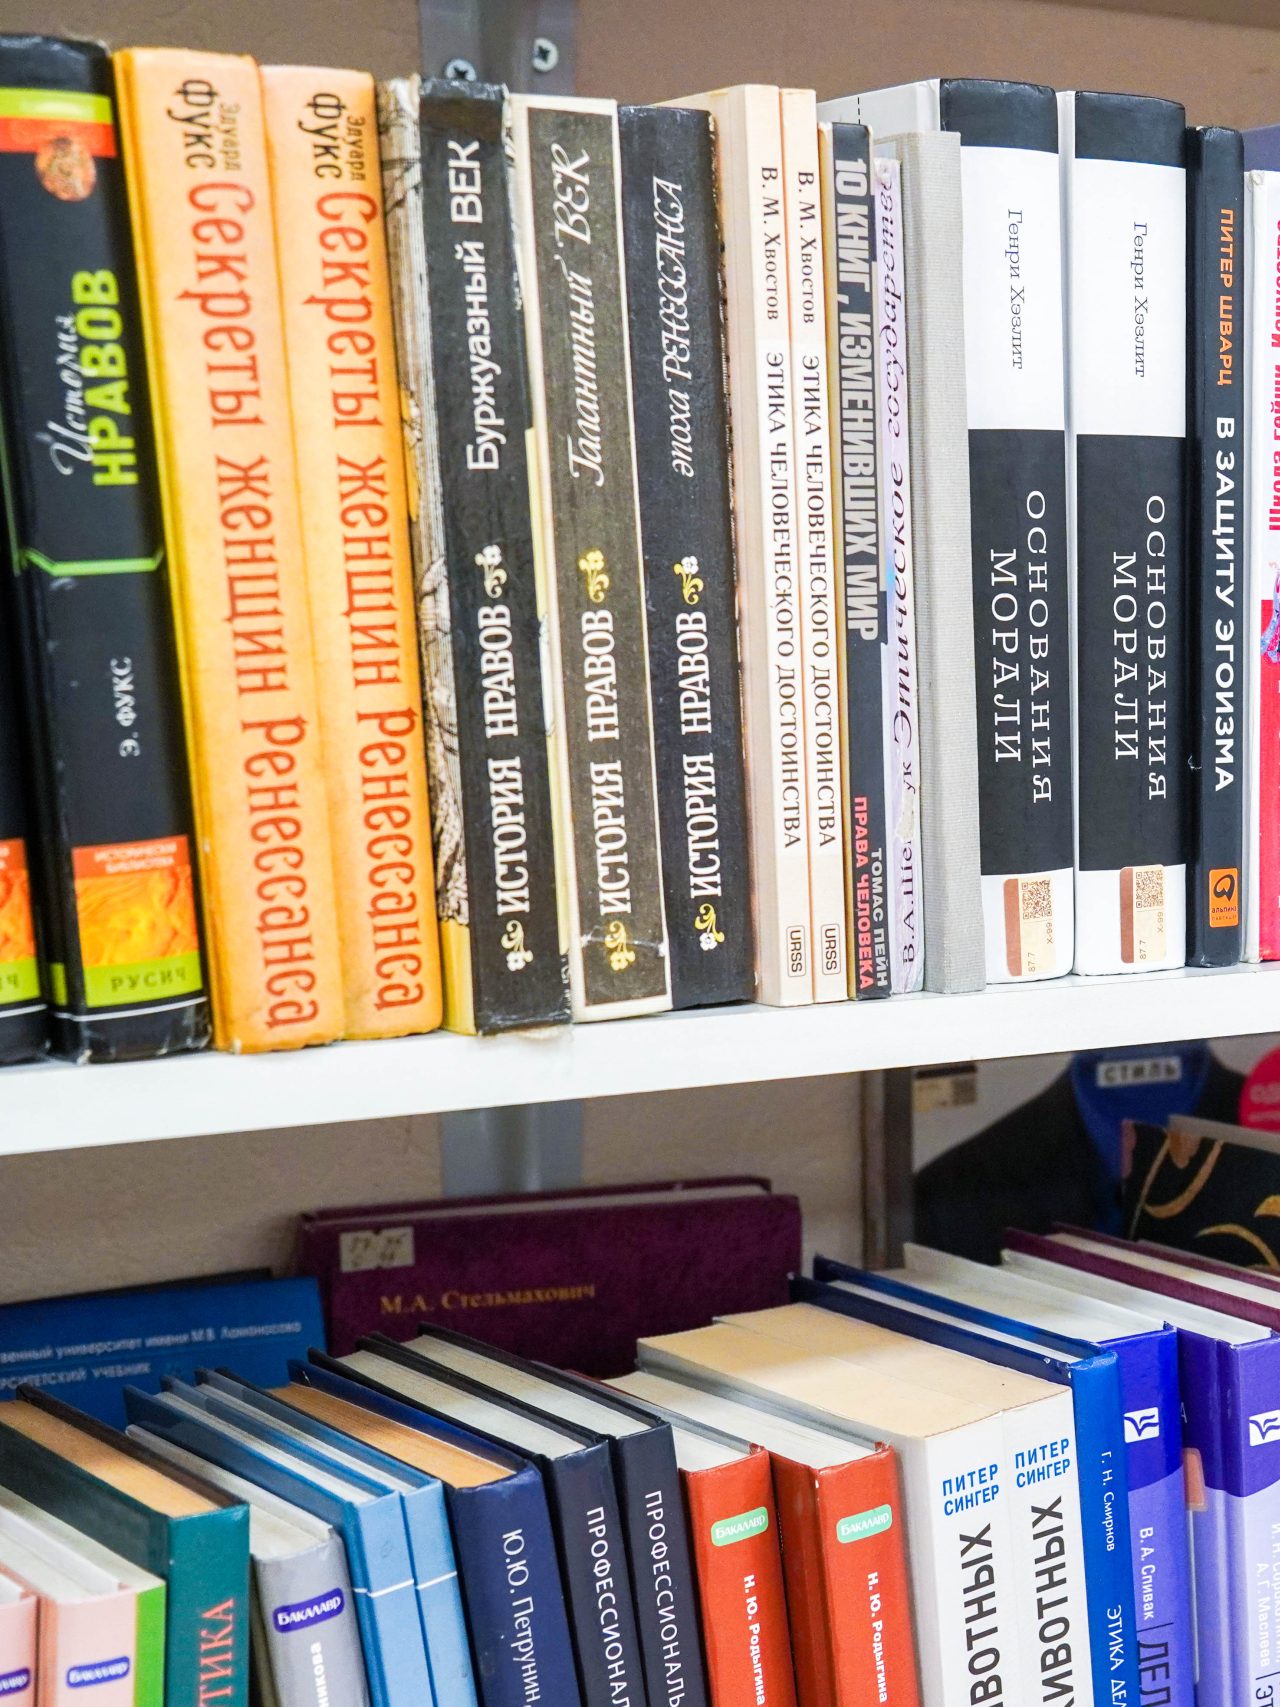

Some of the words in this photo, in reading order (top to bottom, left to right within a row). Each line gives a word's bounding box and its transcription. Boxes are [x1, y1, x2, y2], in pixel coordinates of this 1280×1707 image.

[166, 79, 217, 170] Фукс
[219, 104, 241, 171] Эдуард
[297, 92, 347, 179] Фукс
[348, 115, 365, 182] Эдуард
[447, 140, 483, 224] ВЕК
[550, 142, 591, 248] ВЕК
[761, 166, 778, 188] В.
[762, 196, 780, 224] М.
[834, 158, 868, 196] 10
[653, 176, 692, 381] РЕНЕССАНСА
[764, 232, 781, 320] Хвостов
[800, 238, 817, 323] Хвостов
[836, 203, 871, 305] КНИГ,
[1004, 209, 1022, 278] Генри
[1131, 222, 1147, 289] Генри
[1220, 209, 1233, 288] ПИТЕР
[455, 240, 506, 471] Буржуазный
[554, 253, 605, 486] Галантный
[1010, 285, 1024, 369] Хэзлит
[1135, 296, 1149, 377] Хэзлит
[1217, 296, 1233, 385] ШВАРЦ
[40, 312, 98, 476] История
[72, 269, 138, 485] НРАВОВ
[766, 353, 786, 434] ЭТИКА
[802, 356, 821, 435] ЭТИКА
[664, 391, 695, 478] эпоха
[838, 313, 878, 555] ИЗМЕНИВШИХ
[1217, 417, 1234, 438] В
[770, 443, 795, 657] ЧЕЛОВЕЧЕСКОГО
[805, 445, 830, 658] ЧЕЛОВЕЧЕСКОГО
[1215, 451, 1234, 608] ЗАЩИТУ
[174, 182, 264, 429] Секреты
[241, 713, 320, 1030] Ренессанса
[304, 192, 383, 429] Секреты
[356, 706, 424, 1011] Ренессанса
[846, 565, 878, 641] МИР
[891, 462, 912, 749] Этическое
[478, 604, 518, 738] НРАВОВ
[582, 609, 619, 742] НРАВОВ
[676, 611, 712, 735] НРАВОВ
[991, 549, 1021, 763] МОРАЛИ
[1026, 490, 1052, 802] ОСНОВАНИЯ
[1113, 552, 1138, 760] МОРАЛИ
[1146, 496, 1167, 799] ОСНОВАНИЯ
[110, 657, 138, 728] ФУКС
[1215, 618, 1235, 791] ЭГОИЗМА
[777, 665, 801, 848] ДОСТОИНСТВА
[812, 667, 836, 847] ДОСТОИНСТВА
[488, 756, 530, 916] ИСТОРИЯ
[590, 760, 631, 916] ИСТОРИЯ
[683, 754, 722, 899] ИСТОРИЯ
[853, 796, 868, 868] ПРАВА
[871, 848, 884, 921] ТОМАС
[788, 929, 802, 973] URSS
[824, 928, 838, 971] URSS
[856, 873, 874, 989] ЧЕЛОВЕКА
[873, 933, 889, 987] ПЕЙН
[110, 966, 187, 992] РУСИЧ
[441, 1284, 595, 1311] Стельмахович
[942, 1463, 999, 1497] ПИТЕР
[1015, 1438, 1069, 1469] ПИТЕР
[1016, 1459, 1070, 1489] СИНГЕР
[944, 1484, 999, 1517] СИНГЕР
[1103, 1491, 1115, 1551] Смирнов
[502, 1529, 530, 1595] Ю.Ю.
[1141, 1564, 1154, 1620] Спивак
[748, 1622, 765, 1706] Родыгина
[873, 1619, 888, 1704] Родыгина
[1107, 1605, 1125, 1671] ЭТИКА
